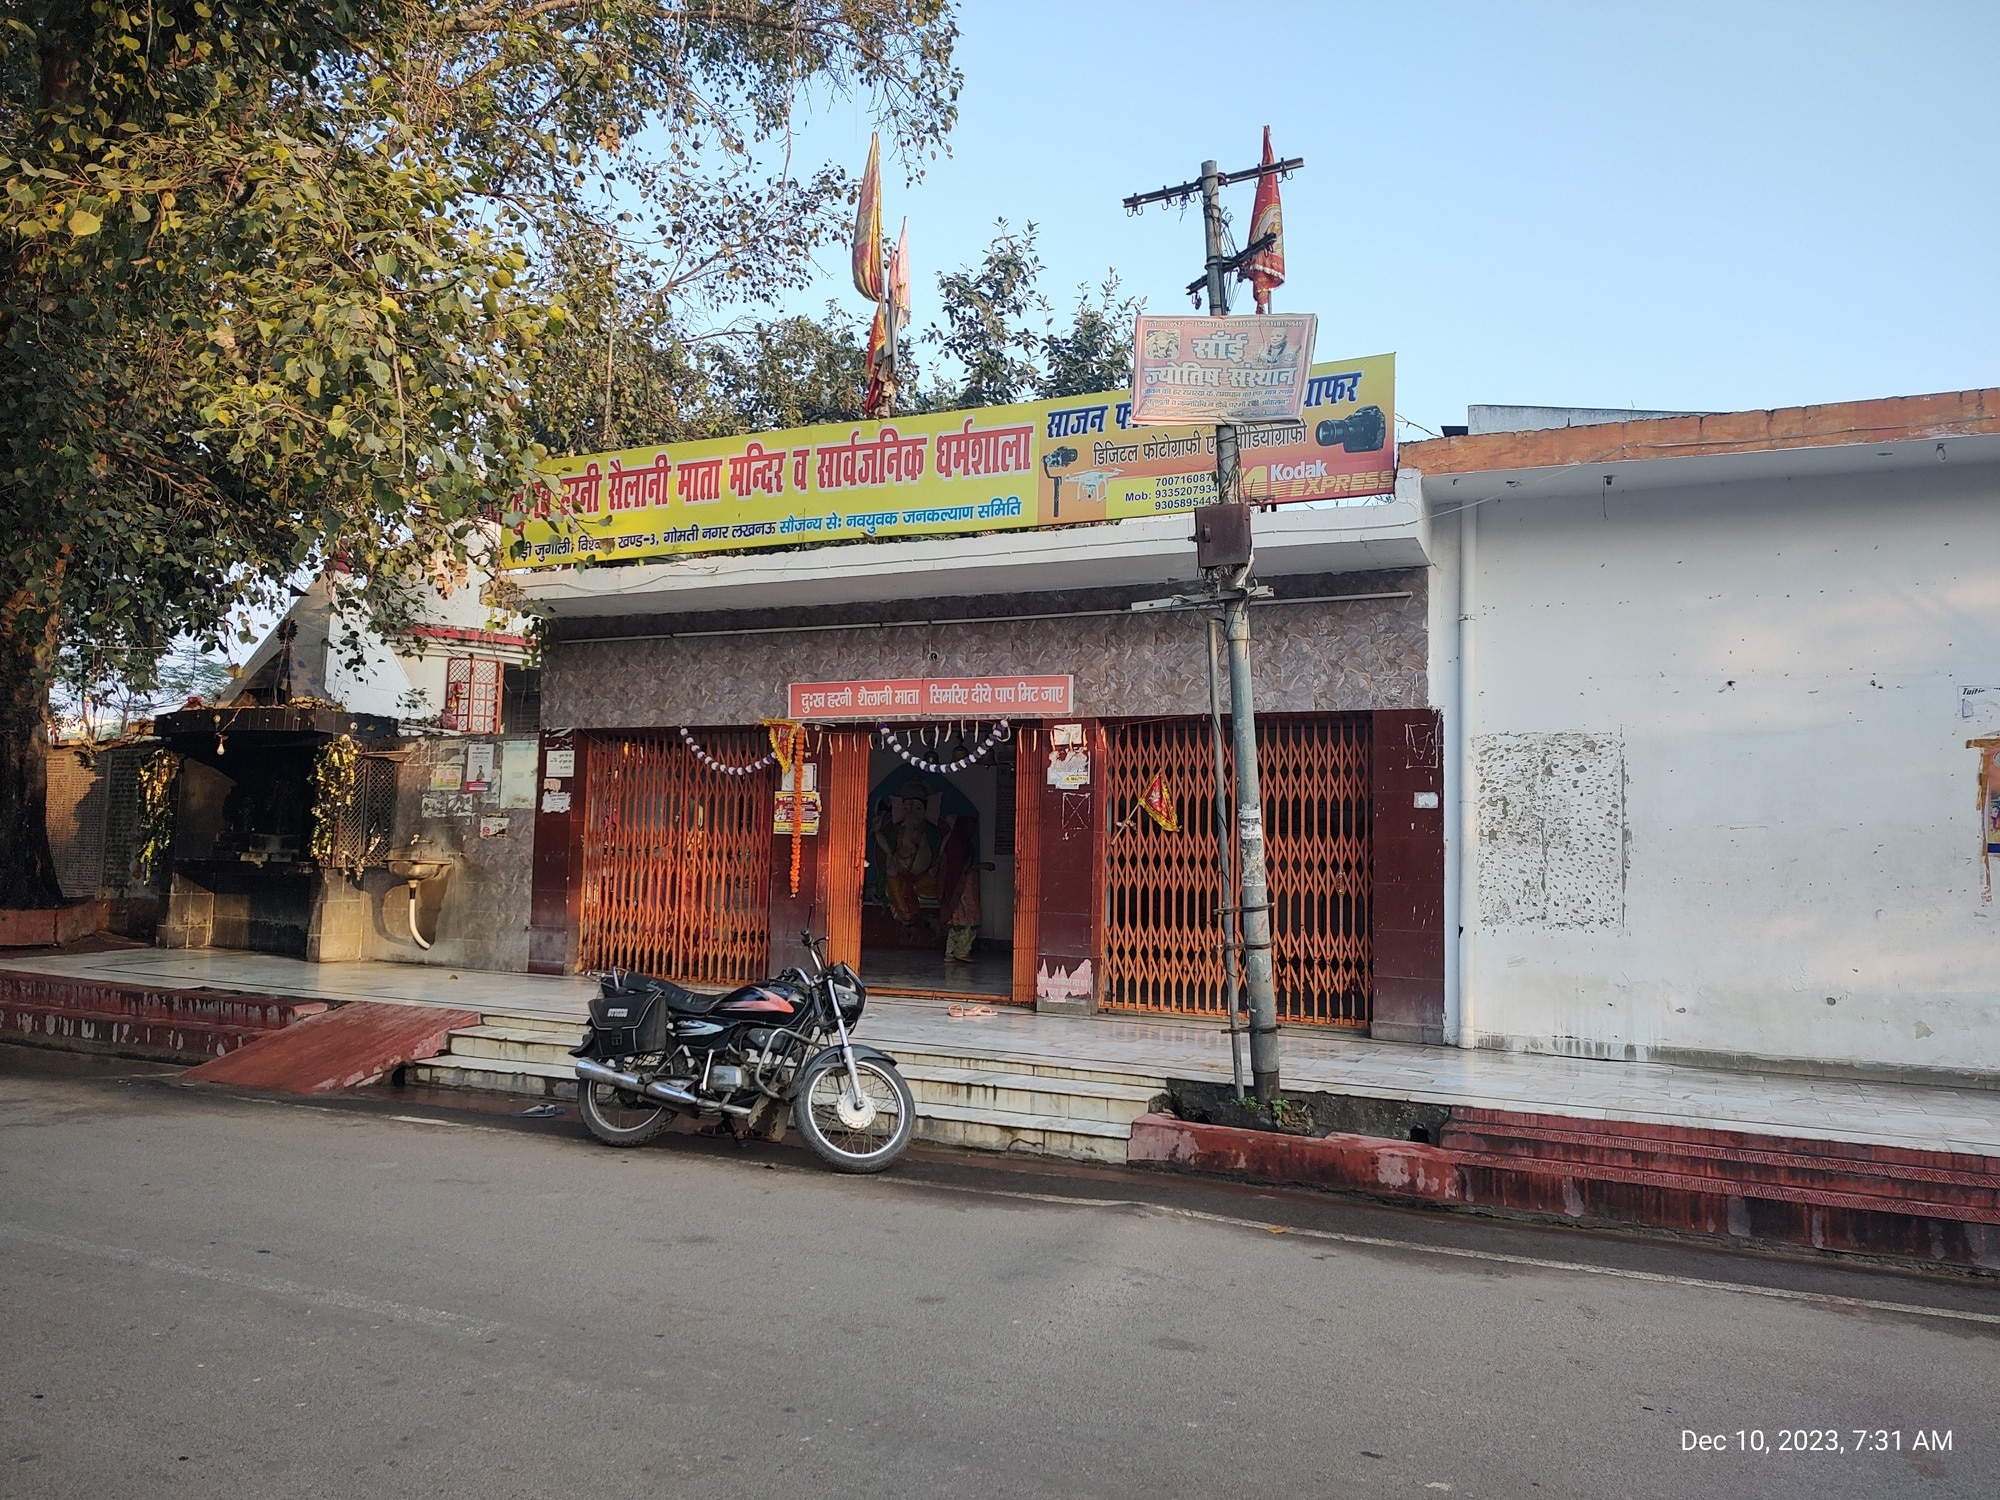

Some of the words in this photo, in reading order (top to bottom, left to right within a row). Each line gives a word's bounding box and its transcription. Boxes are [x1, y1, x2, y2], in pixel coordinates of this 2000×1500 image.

[1143, 361, 1223, 387] ज्योतिष
[1228, 362, 1298, 388] संस्थान
[1047, 405, 1108, 438] साजन
[1093, 441, 1138, 466] डिजिटल
[1143, 430, 1201, 459] फोटोग्राफी
[608, 454, 671, 510] सैलानी
[678, 460, 722, 501] माता
[729, 443, 786, 497] मन्दिर
[793, 450, 810, 490] व
[817, 428, 927, 488] सार्वजनिक
[937, 419, 1033, 477] धर्मशाला
[1271, 460, 1327, 481] Kodak
[1125, 491, 1151, 502] Mob:
[1155, 485, 1218, 499] 9335207934
[1156, 473, 1214, 487] 700716087
[1290, 471, 1394, 497] EXPRESS
[663, 524, 699, 543] गोमती
[702, 526, 730, 540] नगर
[732, 522, 776, 539] लखनऊ
[779, 515, 823, 534] सौजन्य
[846, 512, 899, 534] नवयुवक
[902, 506, 974, 524] जनकल्याण
[978, 496, 1022, 519] समिति
[827, 686, 852, 708] हरनी
[857, 685, 892, 707] शैलानी
[894, 689, 919, 705] माता
[994, 686, 1016, 704] पाप
[1017, 681, 1040, 703] मिट
[1040, 686, 1065, 704] जाए
